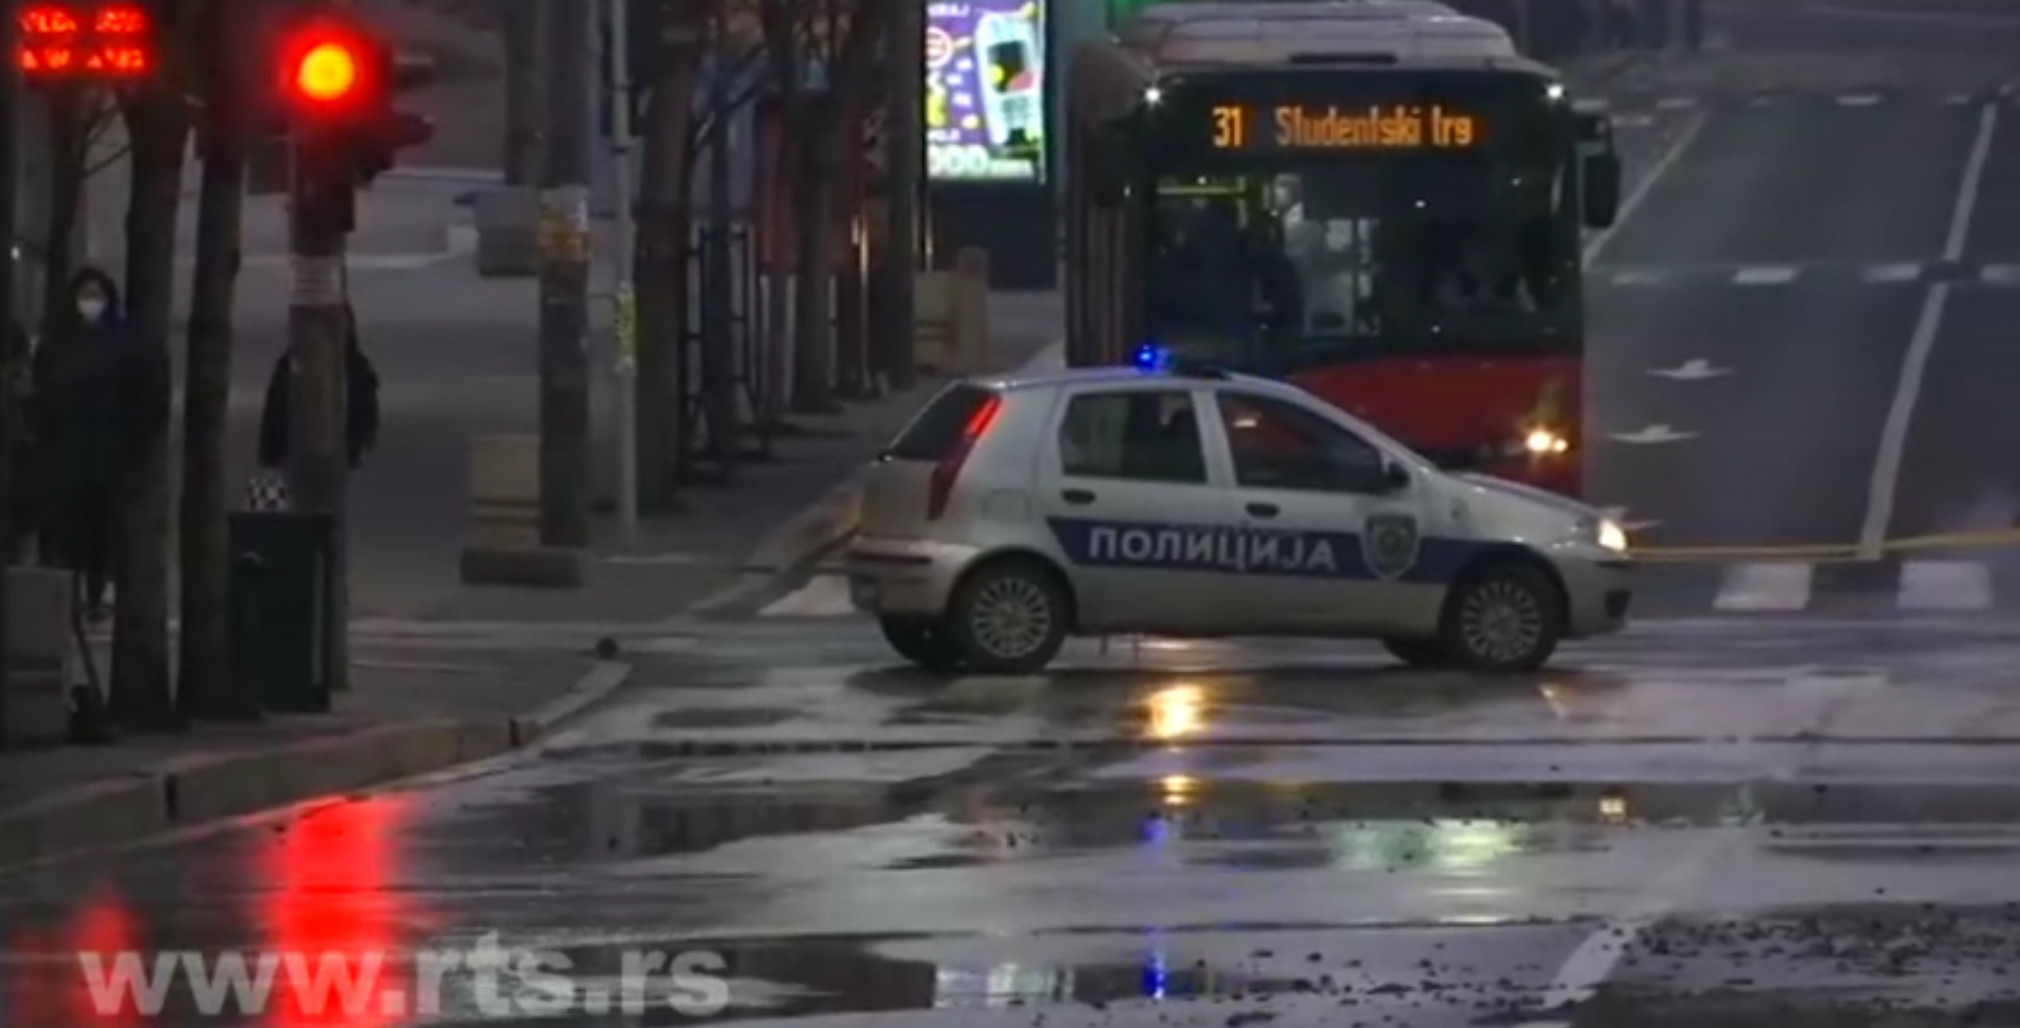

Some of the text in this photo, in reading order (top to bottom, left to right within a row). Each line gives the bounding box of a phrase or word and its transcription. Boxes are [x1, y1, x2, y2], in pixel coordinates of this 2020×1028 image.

[1213, 106, 1244, 147] 31
[1275, 104, 1420, 147] Studentski
[1088, 526, 1338, 571] ПОЛИЦИЈА
